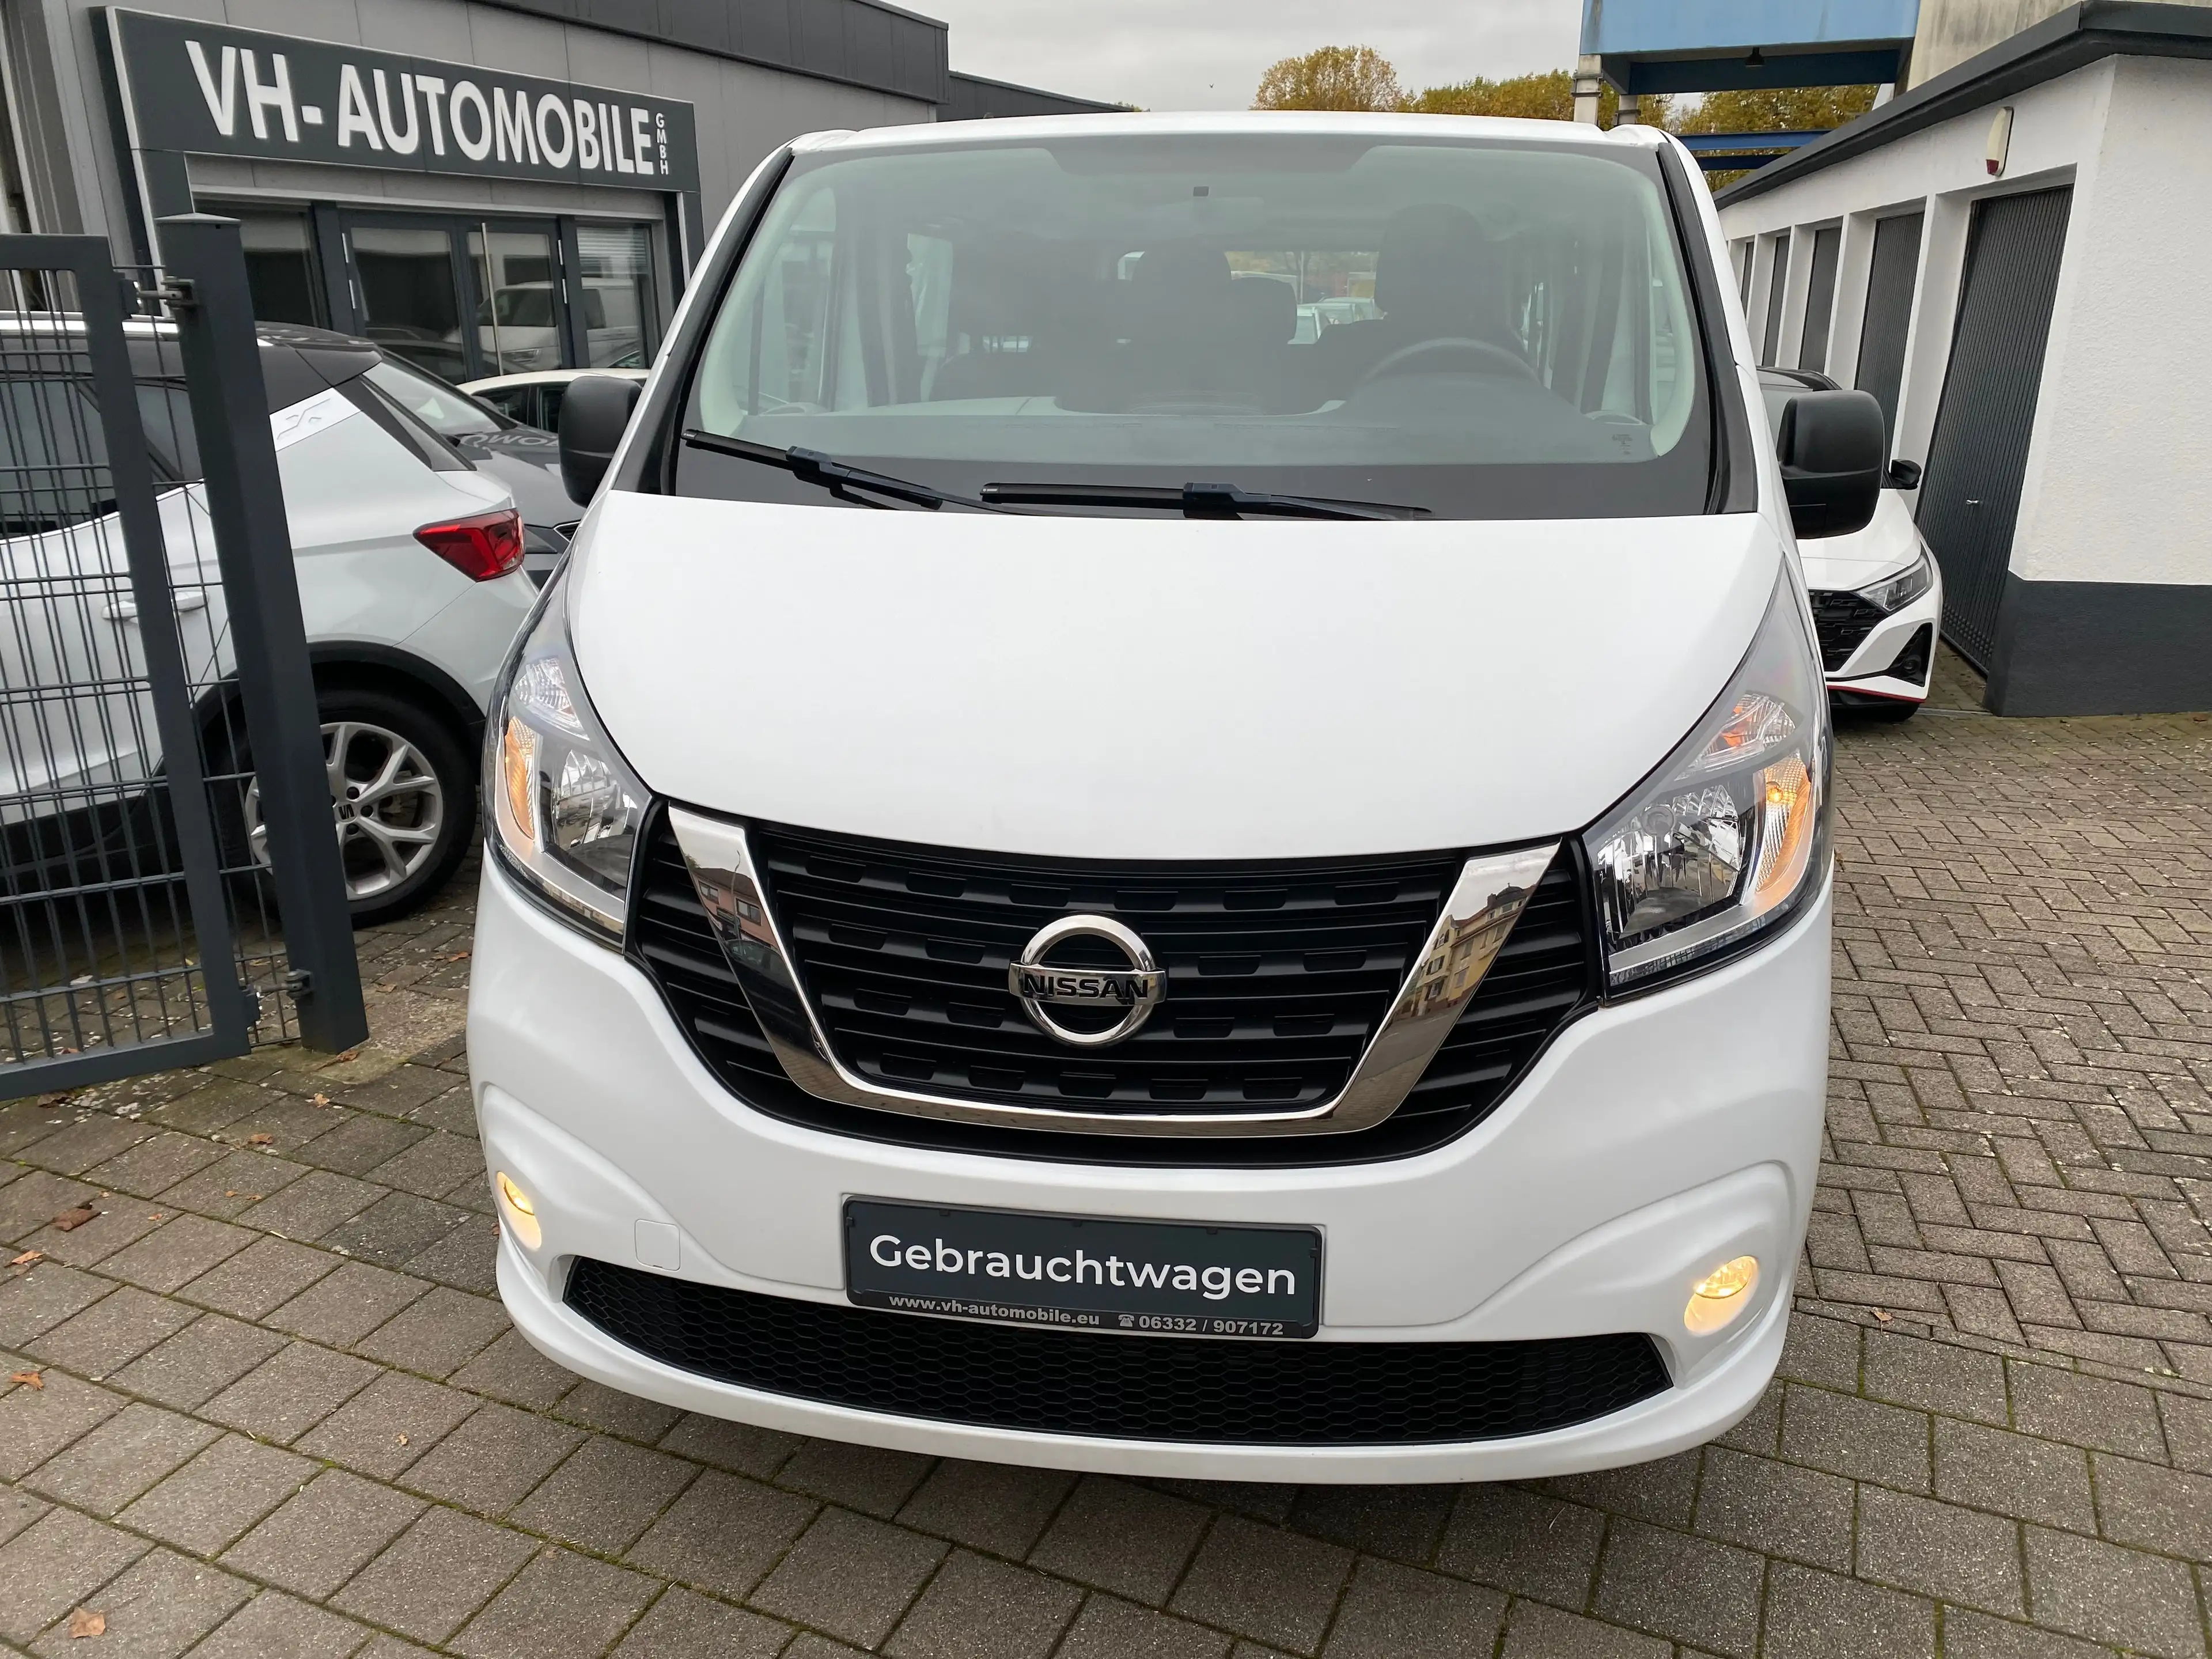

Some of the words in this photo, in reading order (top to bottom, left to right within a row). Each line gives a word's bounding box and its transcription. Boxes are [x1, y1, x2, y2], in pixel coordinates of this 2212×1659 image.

[656, 112, 669, 175] GMBH
[1024, 975, 1148, 998] NISSAN
[869, 1234, 1296, 1300] Gebrauchtwagen
[889, 1296, 1100, 1325] www.vh-automobile.eu
[1138, 1316, 1196, 1331] 06332
[1213, 1320, 1284, 1335] 907172
